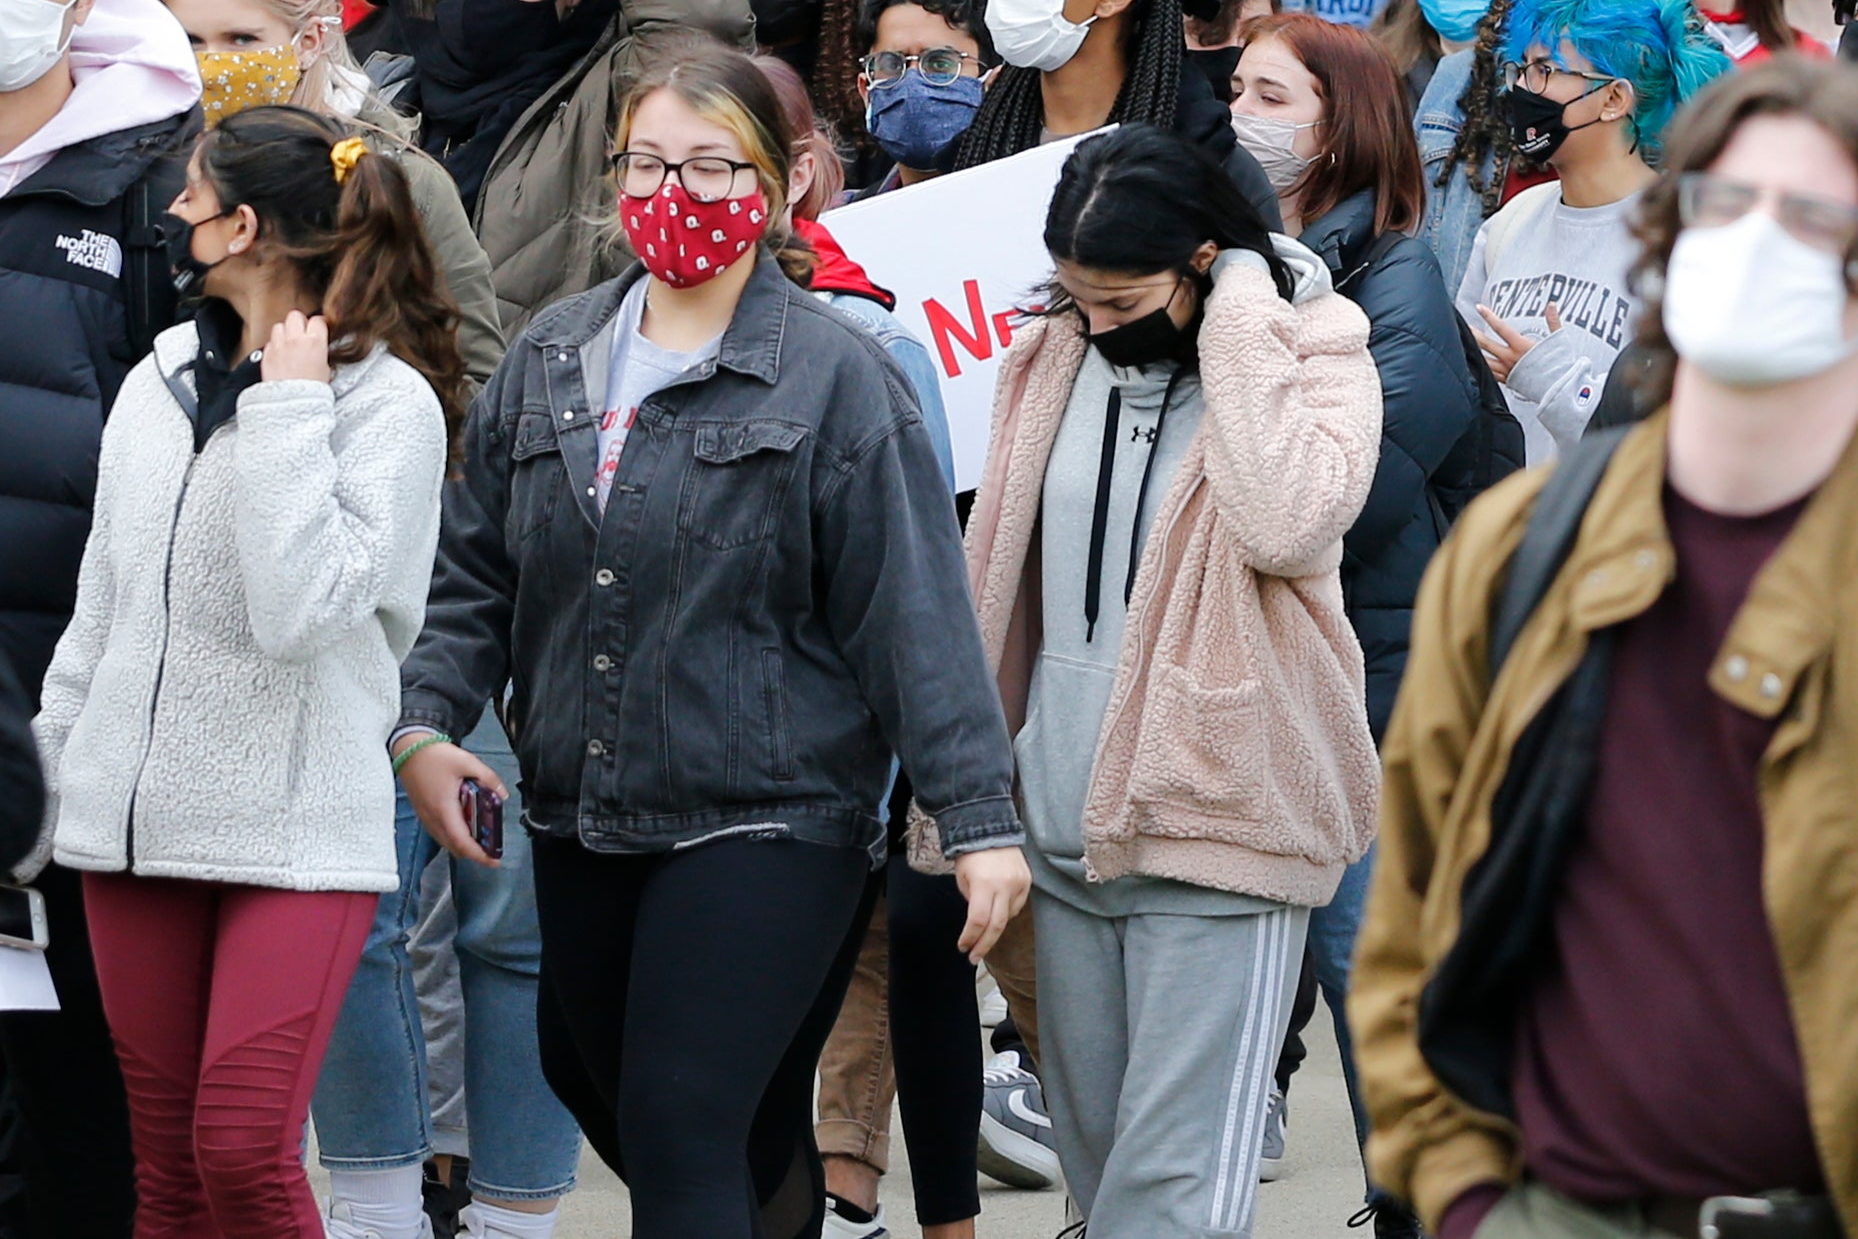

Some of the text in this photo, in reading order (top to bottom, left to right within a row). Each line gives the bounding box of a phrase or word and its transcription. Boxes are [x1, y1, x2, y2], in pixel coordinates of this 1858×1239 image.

[55, 234, 106, 257] NORTH
[81, 229, 110, 247] THE
[66, 249, 105, 270] FACE
